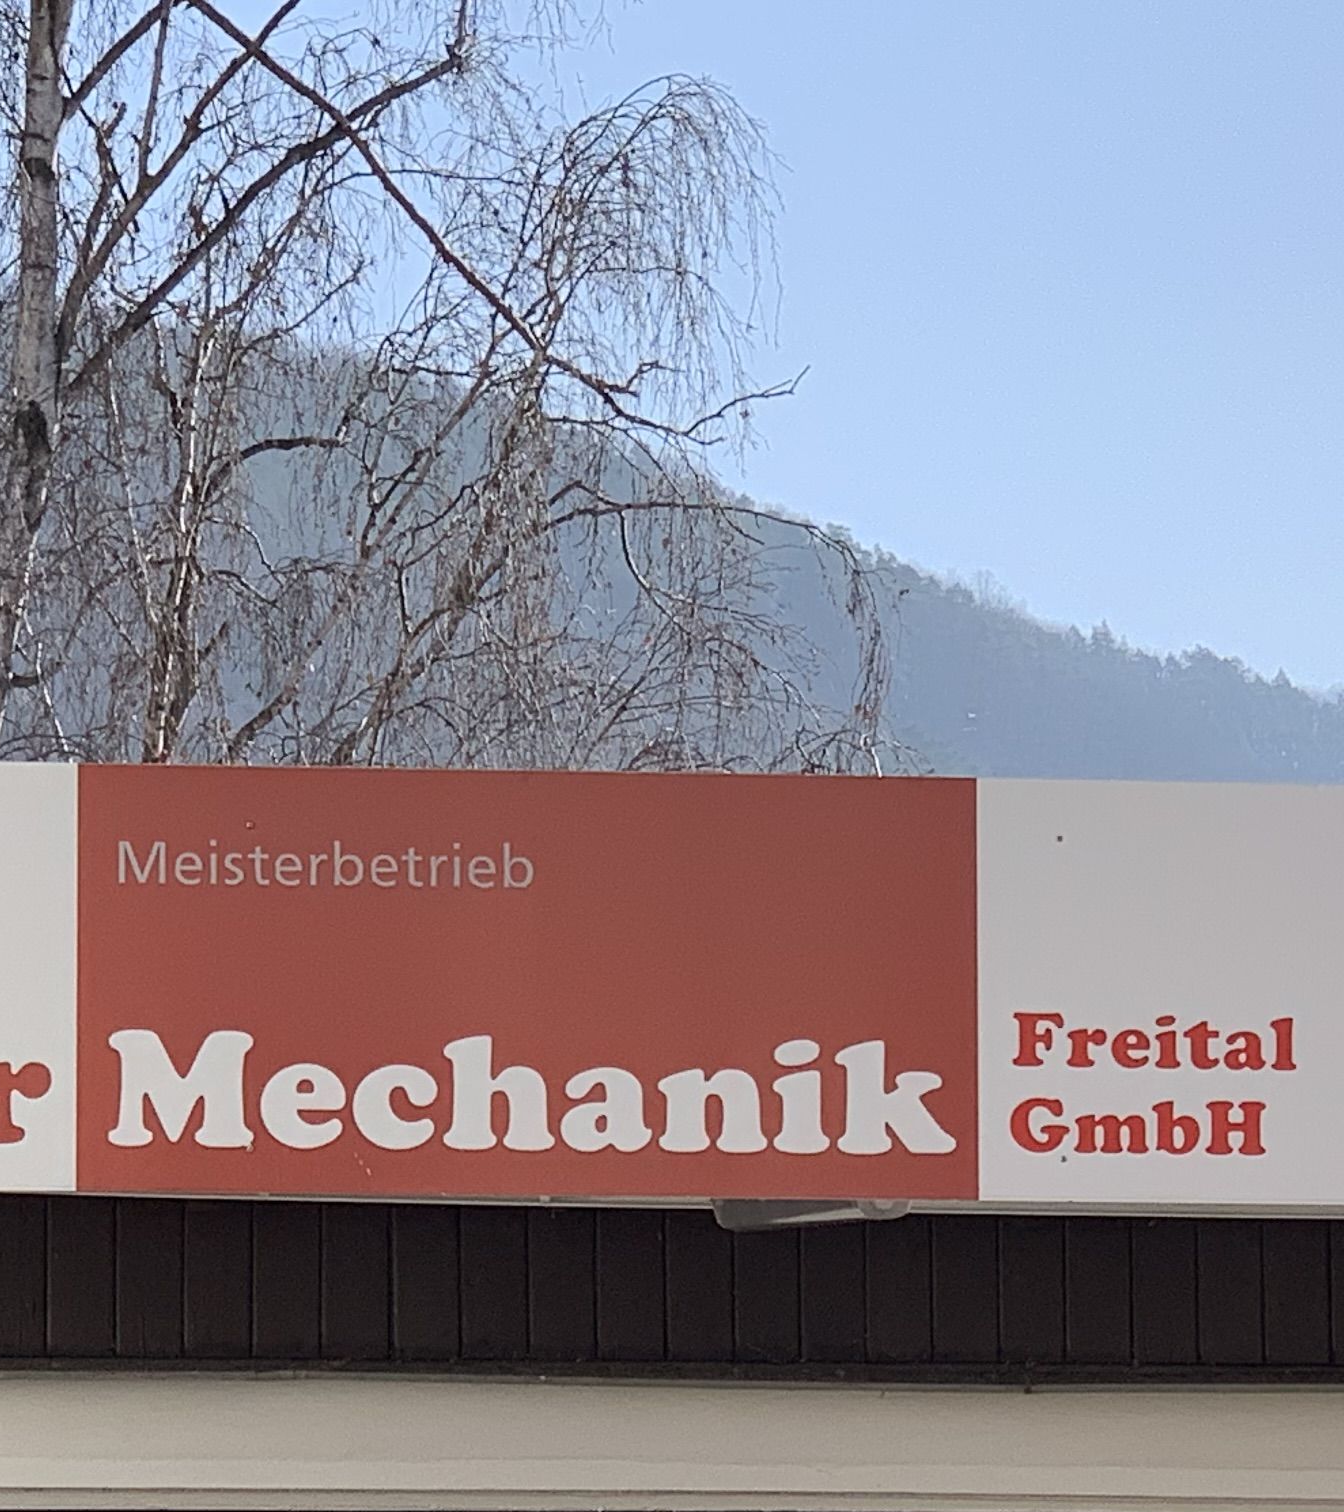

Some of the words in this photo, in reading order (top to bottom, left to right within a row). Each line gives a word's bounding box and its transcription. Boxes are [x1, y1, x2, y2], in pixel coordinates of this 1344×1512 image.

[117, 839, 535, 889] Meisterbetrieb
[1011, 1012, 1297, 1072] Freital
[107, 1029, 957, 1155] Mechanik
[1009, 1098, 1266, 1156] GmbH
